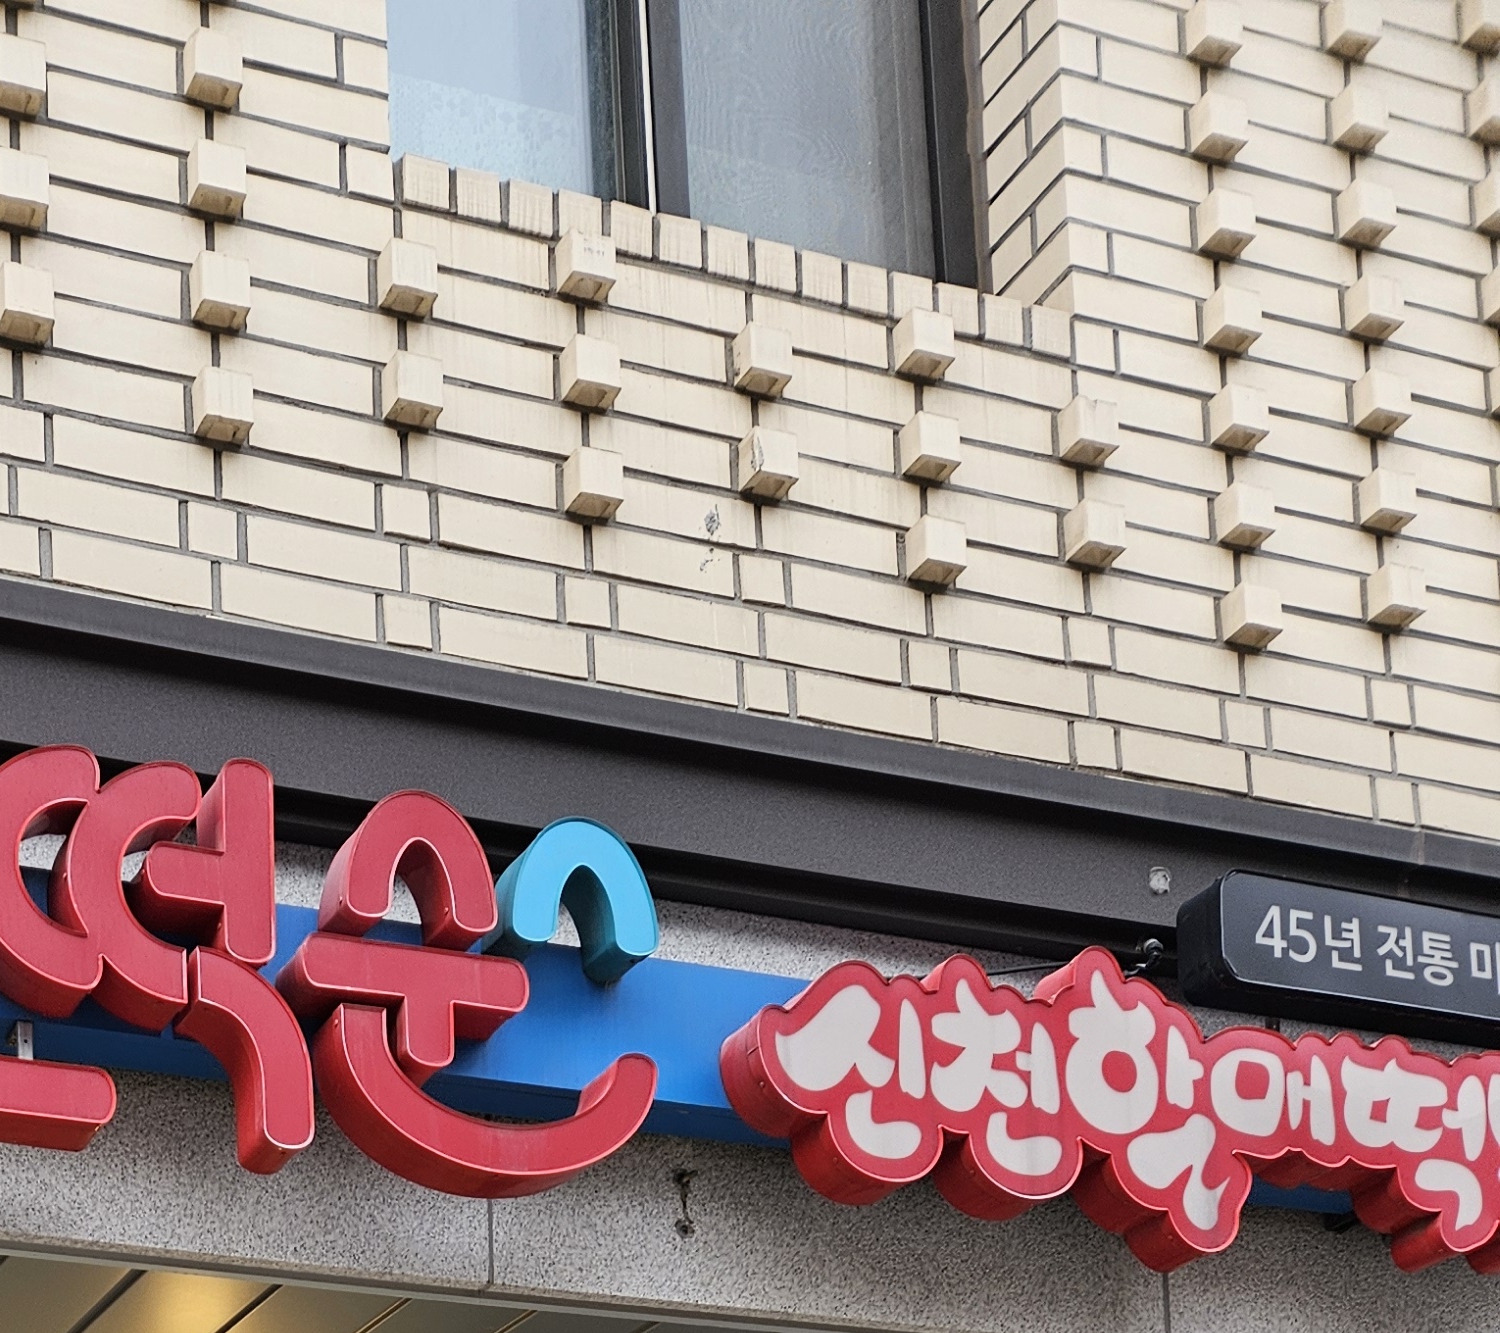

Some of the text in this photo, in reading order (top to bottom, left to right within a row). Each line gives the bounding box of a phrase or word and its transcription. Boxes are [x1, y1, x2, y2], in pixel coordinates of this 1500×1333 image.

[1255, 905, 1458, 986] 45년 전통
[775, 969, 1500, 1232] 신천할매떡
